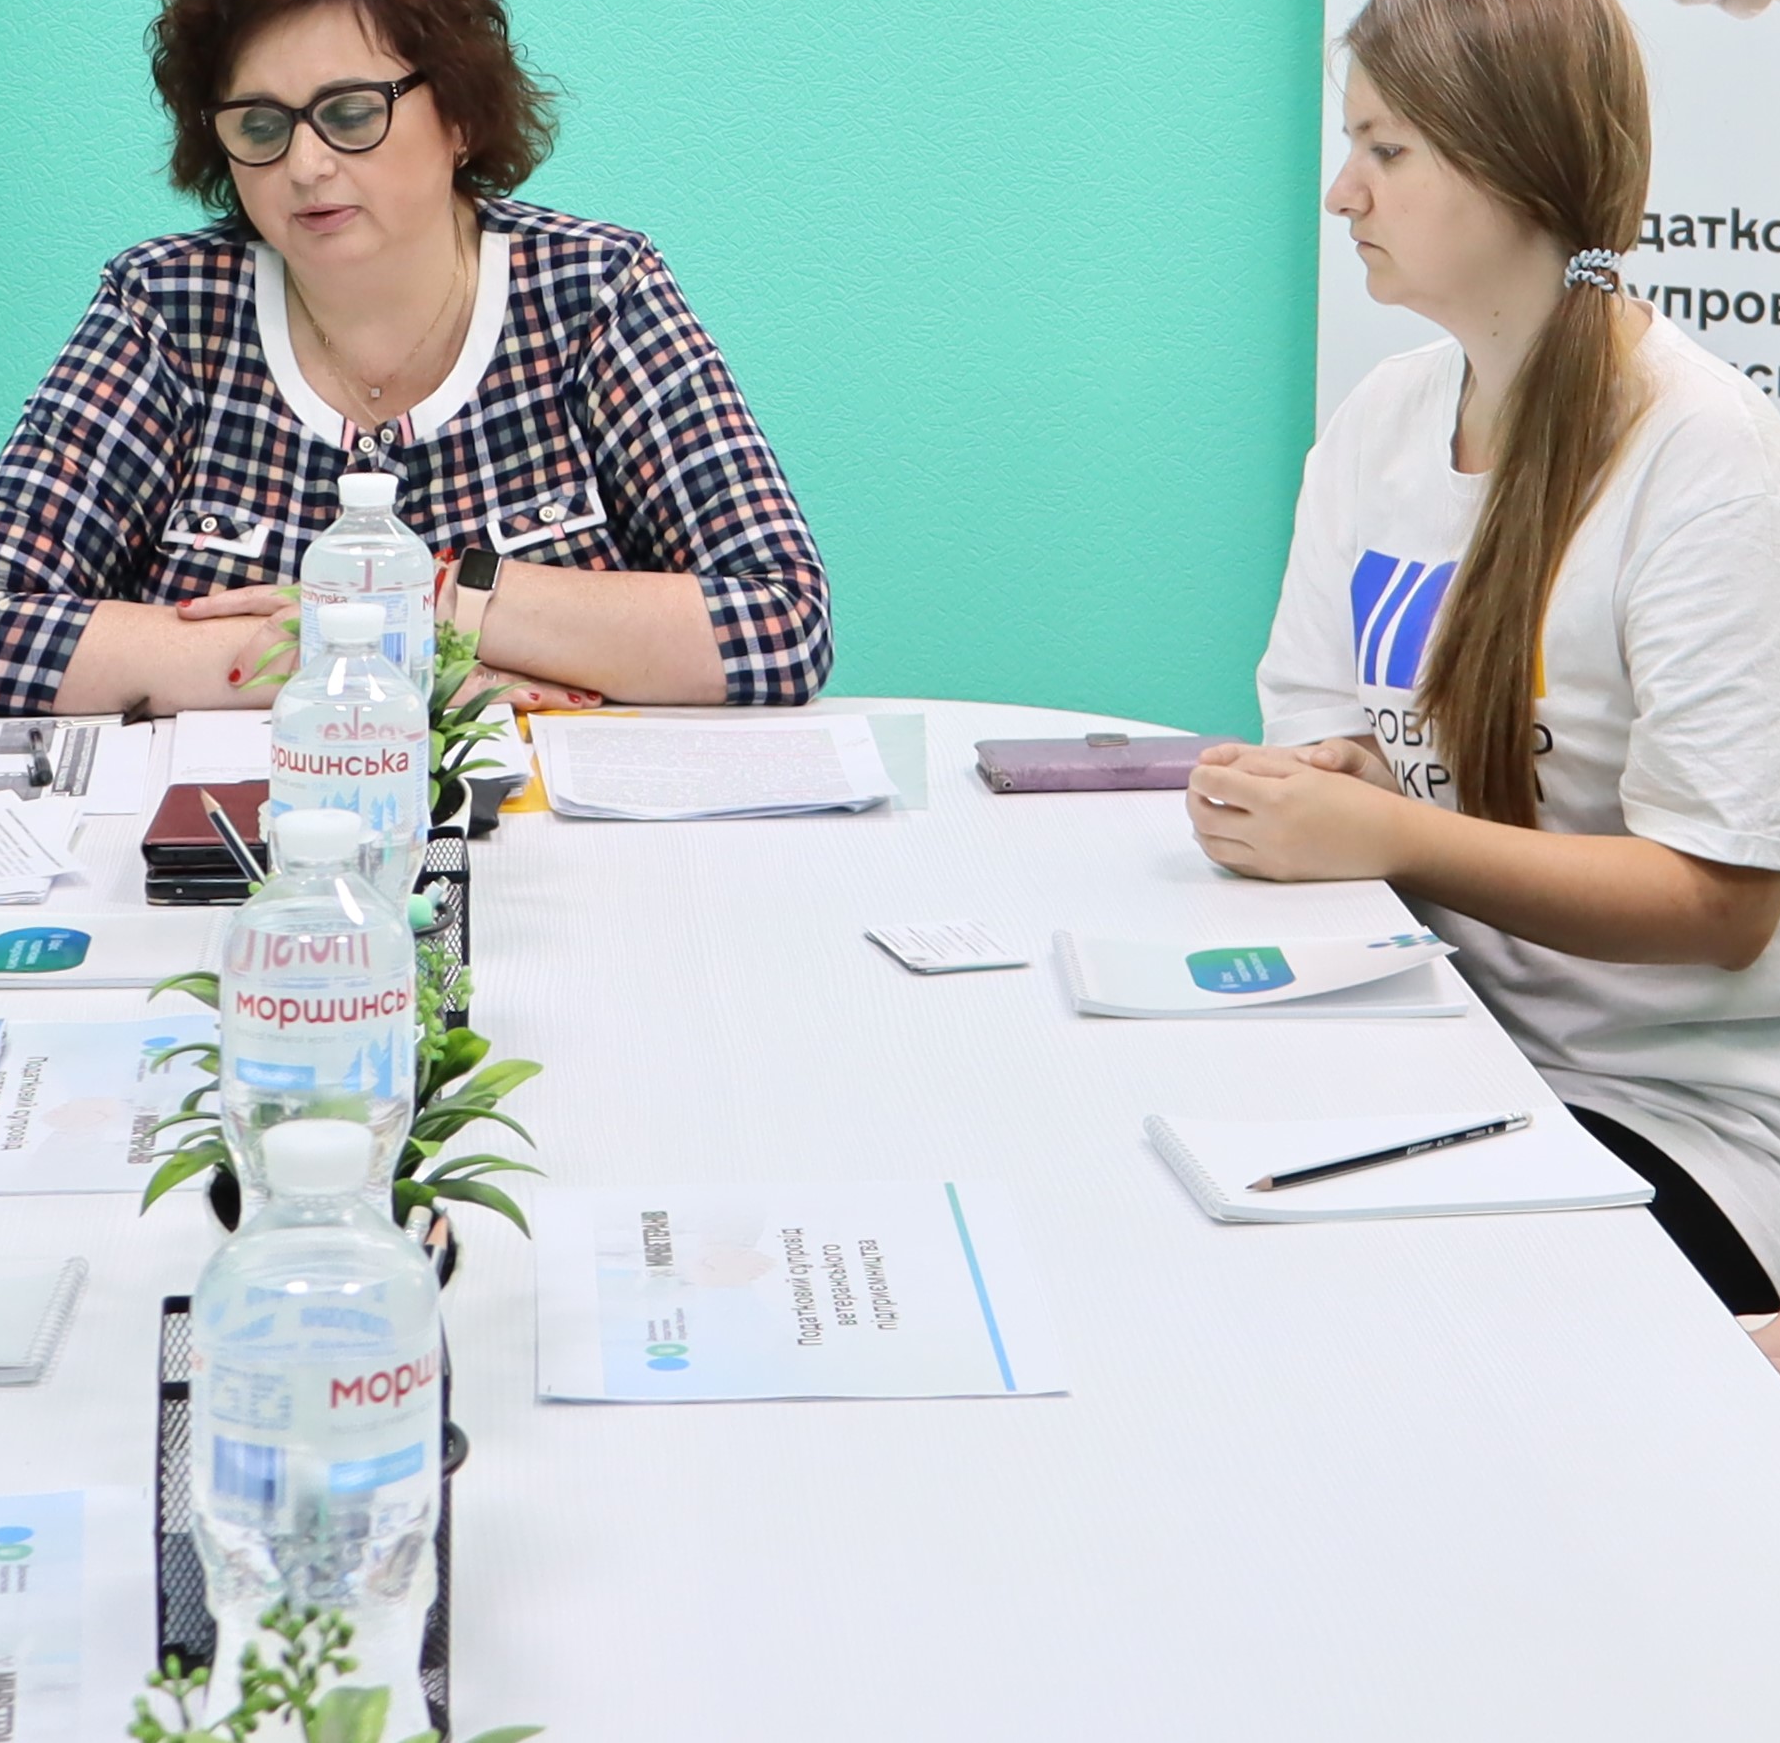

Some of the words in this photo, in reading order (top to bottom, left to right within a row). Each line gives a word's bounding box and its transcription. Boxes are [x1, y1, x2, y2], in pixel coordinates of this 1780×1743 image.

[777, 1227, 814, 1276] супровід
[820, 1243, 858, 1327] ветеранського
[858, 1239, 900, 1331] підприємництва
[785, 1277, 824, 1346] Податковий
